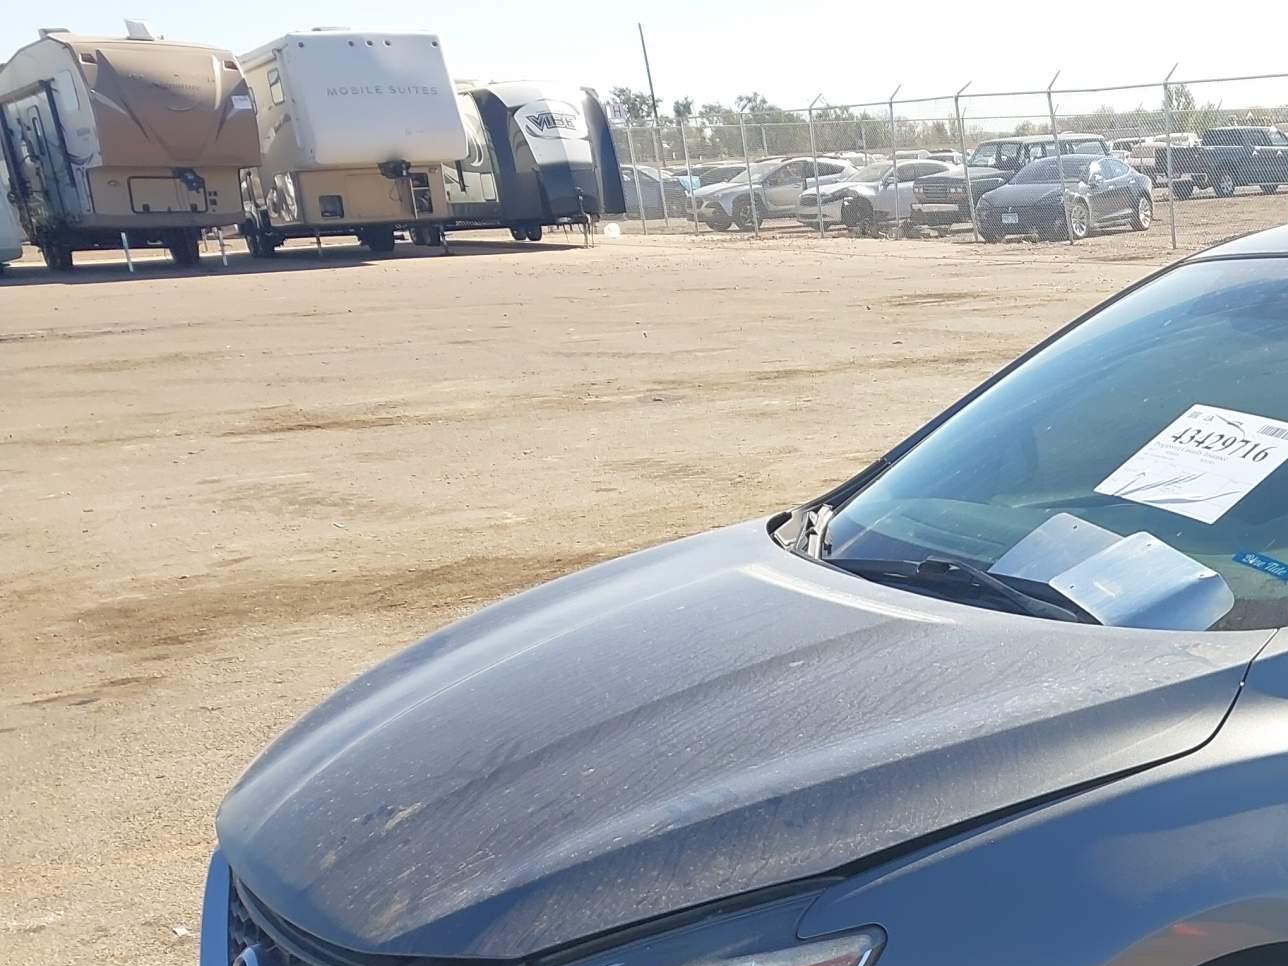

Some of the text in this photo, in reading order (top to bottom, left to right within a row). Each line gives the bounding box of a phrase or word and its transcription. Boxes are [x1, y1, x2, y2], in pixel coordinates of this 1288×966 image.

[326, 85, 439, 96] MOBILE SUITES
[526, 112, 577, 132] VIBE
[1171, 427, 1278, 462] 43429716
